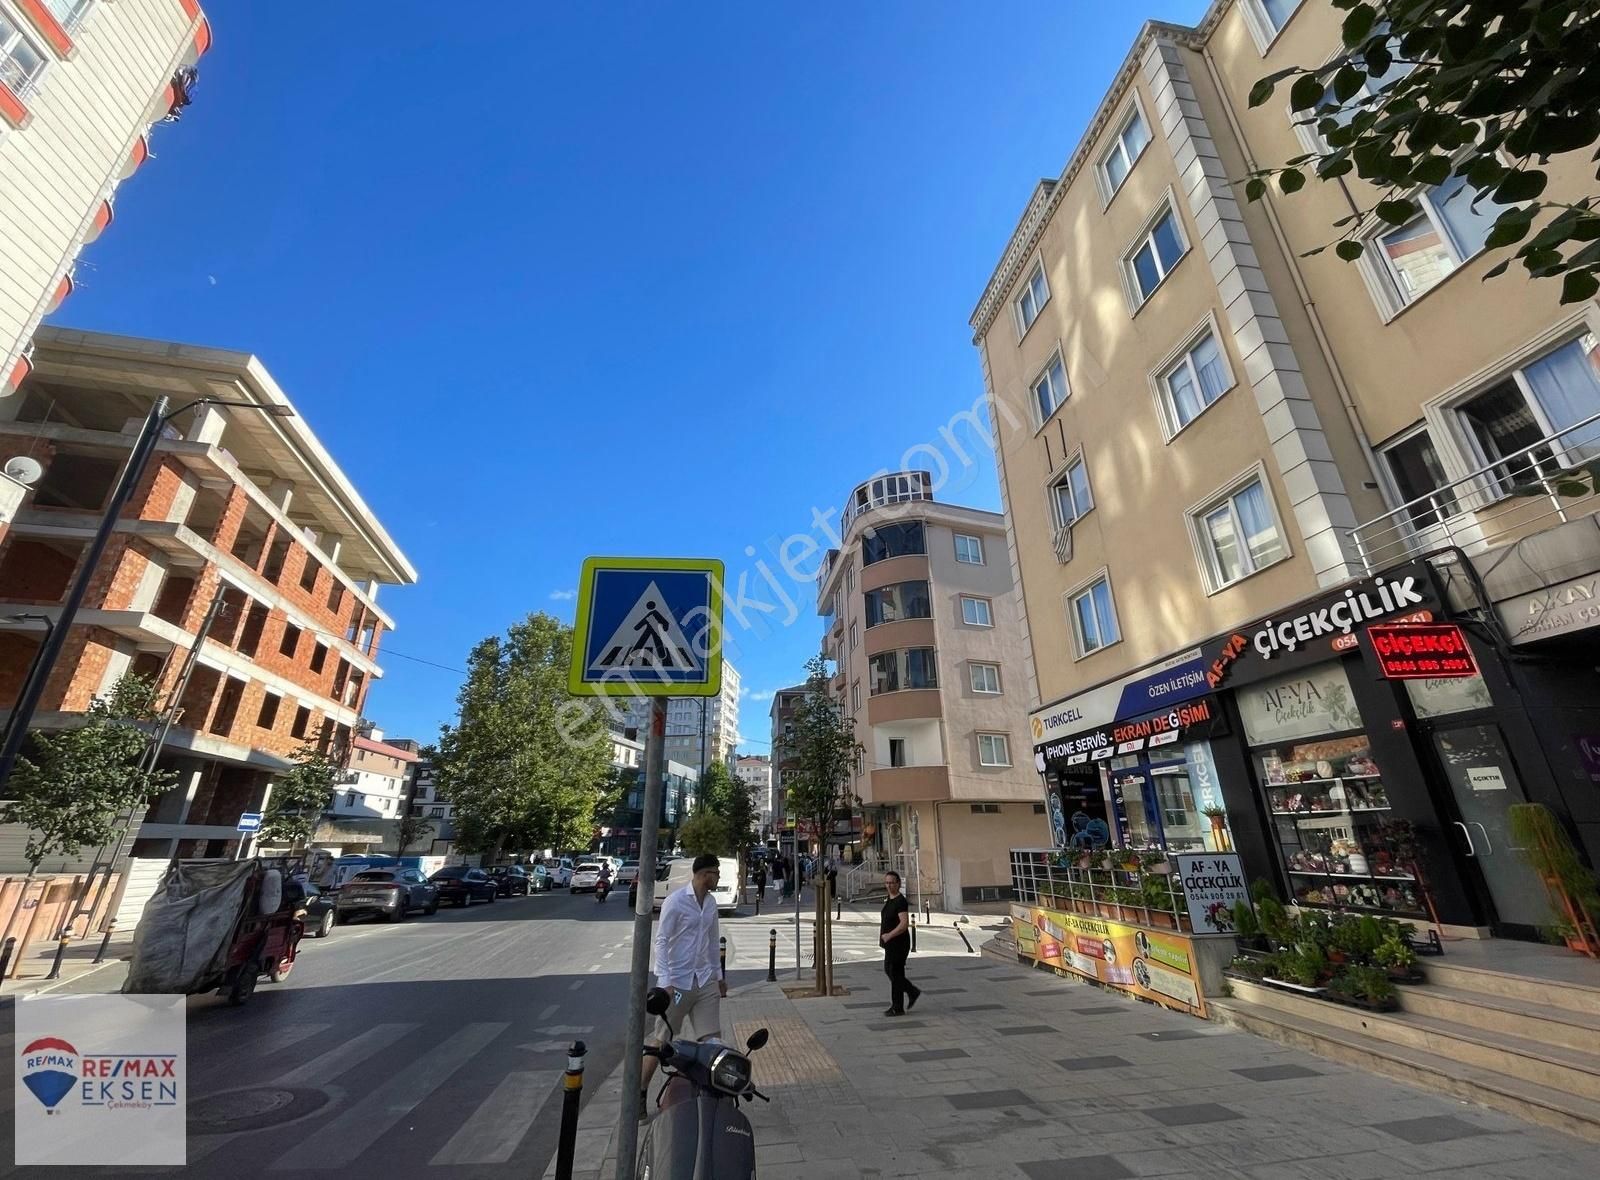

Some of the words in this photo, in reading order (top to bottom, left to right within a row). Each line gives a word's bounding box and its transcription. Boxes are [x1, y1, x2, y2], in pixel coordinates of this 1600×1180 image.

[1529, 580, 1597, 615] AKAY
[1206, 634, 1247, 689] AF-YA
[1254, 576, 1423, 660] ÇİÇEKÇİLİK
[1375, 631, 1463, 656] ÇİÇEKÇİ
[1148, 681, 1171, 698] ÖZEN
[1169, 669, 1205, 692] İLETİŞİM
[1043, 707, 1083, 731] TURKCELL
[1076, 730, 1108, 752] SERVİS
[1113, 719, 1151, 743] EKRAN
[1153, 700, 1211, 733] DEĞİŞİMİ
[1185, 873, 1243, 893] ÇİÇEKÇİLİK
[1190, 892, 1209, 901] 0544
